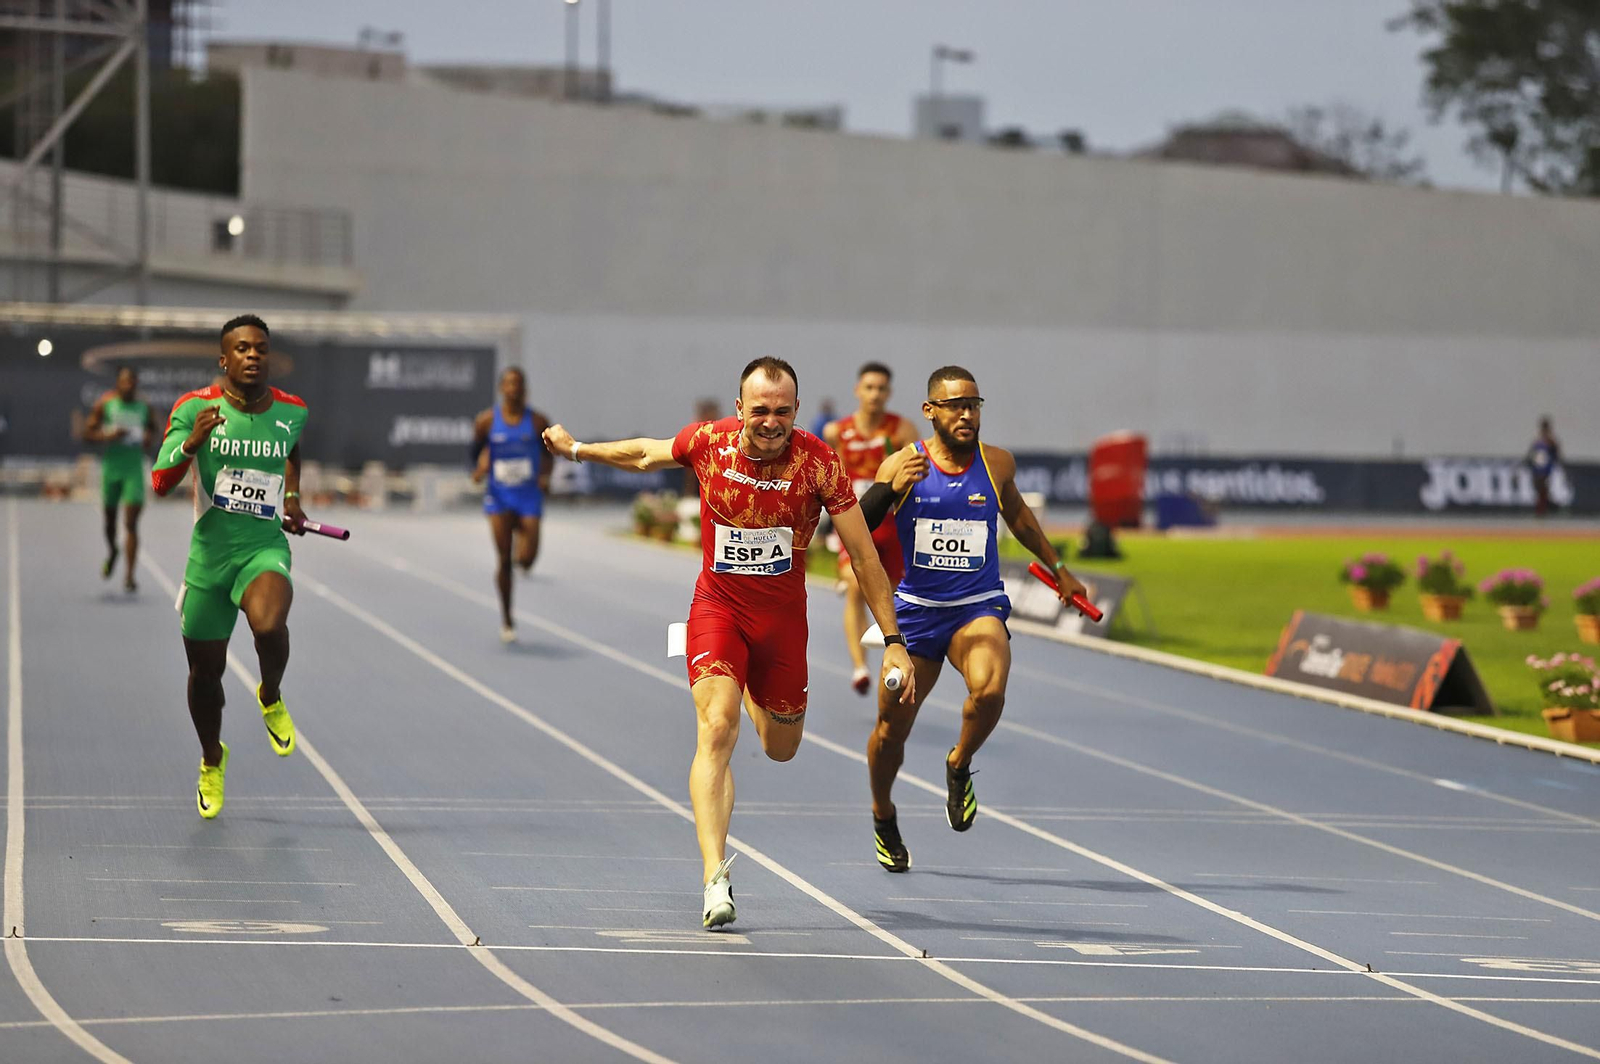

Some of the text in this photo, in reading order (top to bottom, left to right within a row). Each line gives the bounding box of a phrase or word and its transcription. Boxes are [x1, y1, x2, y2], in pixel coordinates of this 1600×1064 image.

[210, 437, 288, 457] PORTUGAL
[722, 467, 793, 491] ESPAÑA
[230, 483, 266, 501] POR
[724, 544, 784, 561] ESP A
[932, 538, 971, 552] COL
